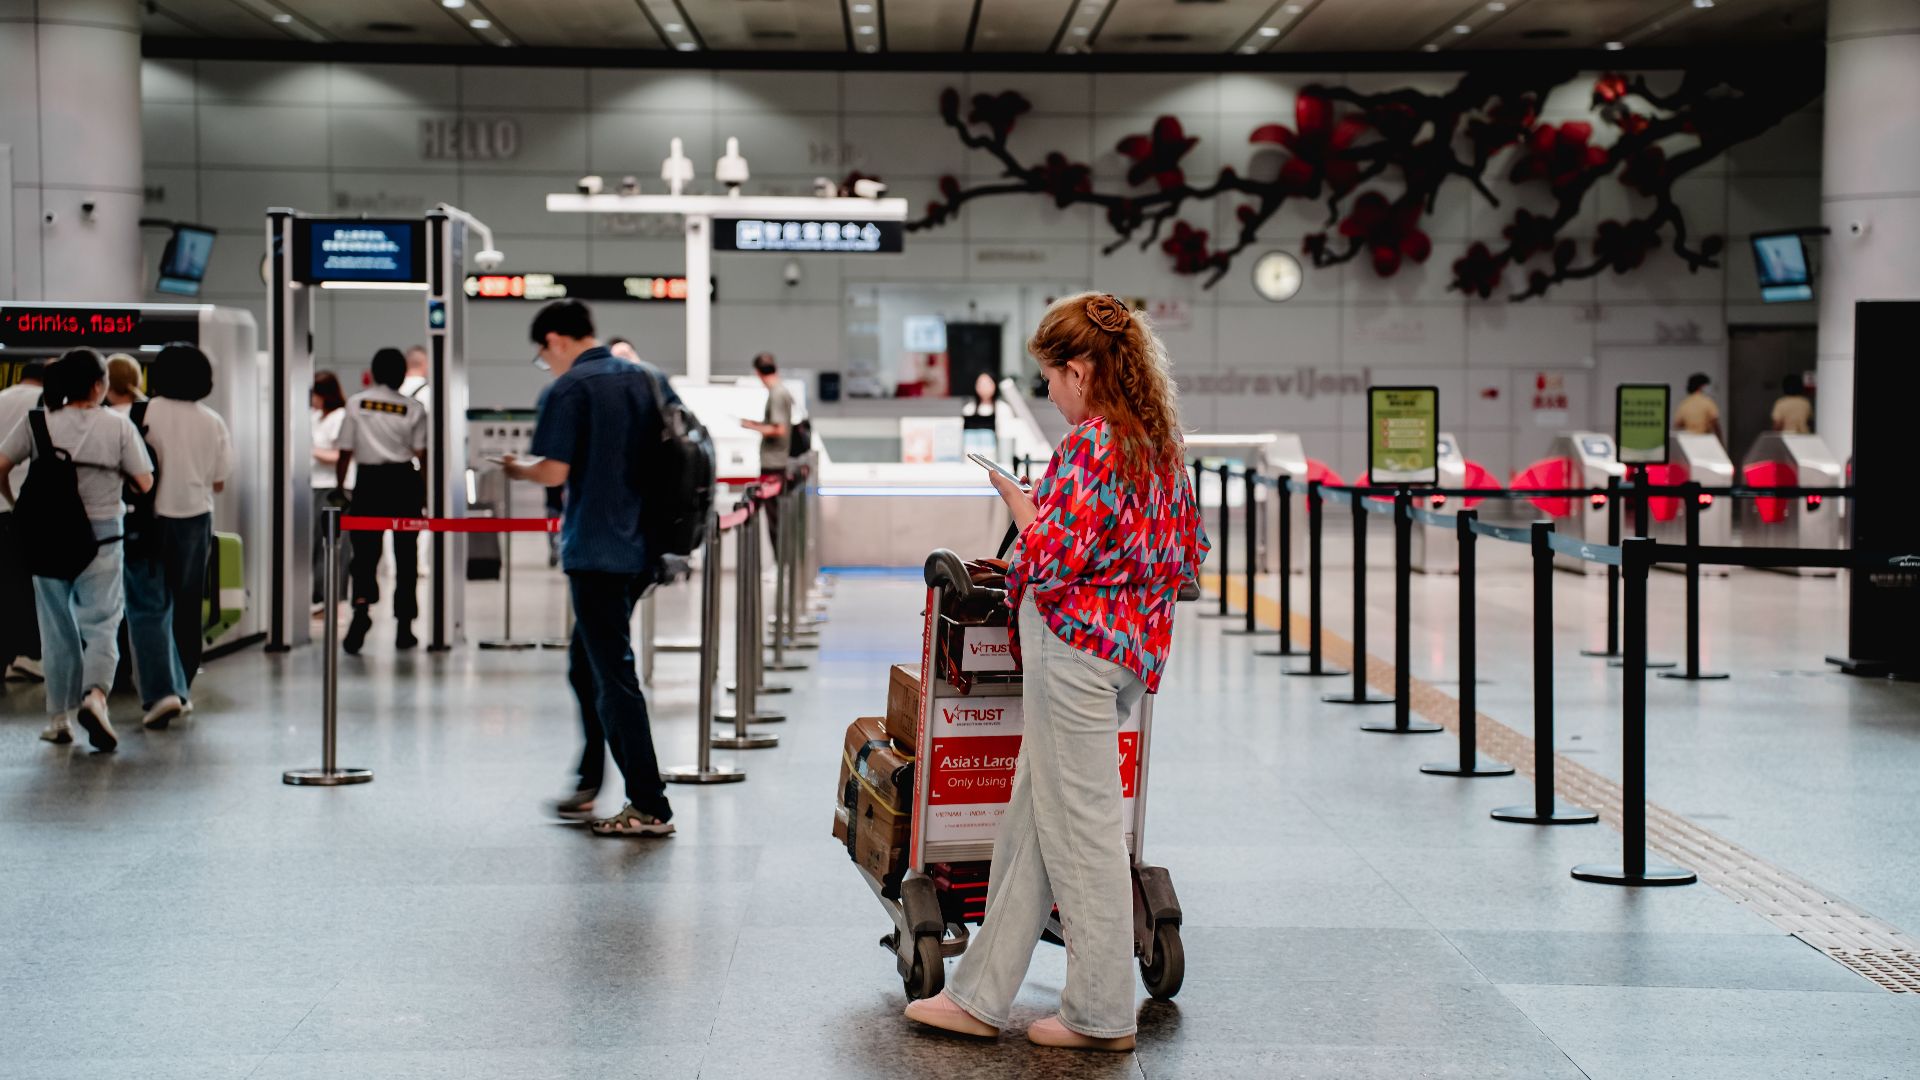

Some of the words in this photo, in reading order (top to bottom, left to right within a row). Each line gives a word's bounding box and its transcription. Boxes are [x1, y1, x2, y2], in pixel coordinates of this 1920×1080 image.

[420, 119, 519, 160] HELLO
[18, 313, 85, 335] drinks,
[940, 756, 980, 769] Asia's
[947, 777, 973, 790] Only
[977, 776, 1007, 789] Using
